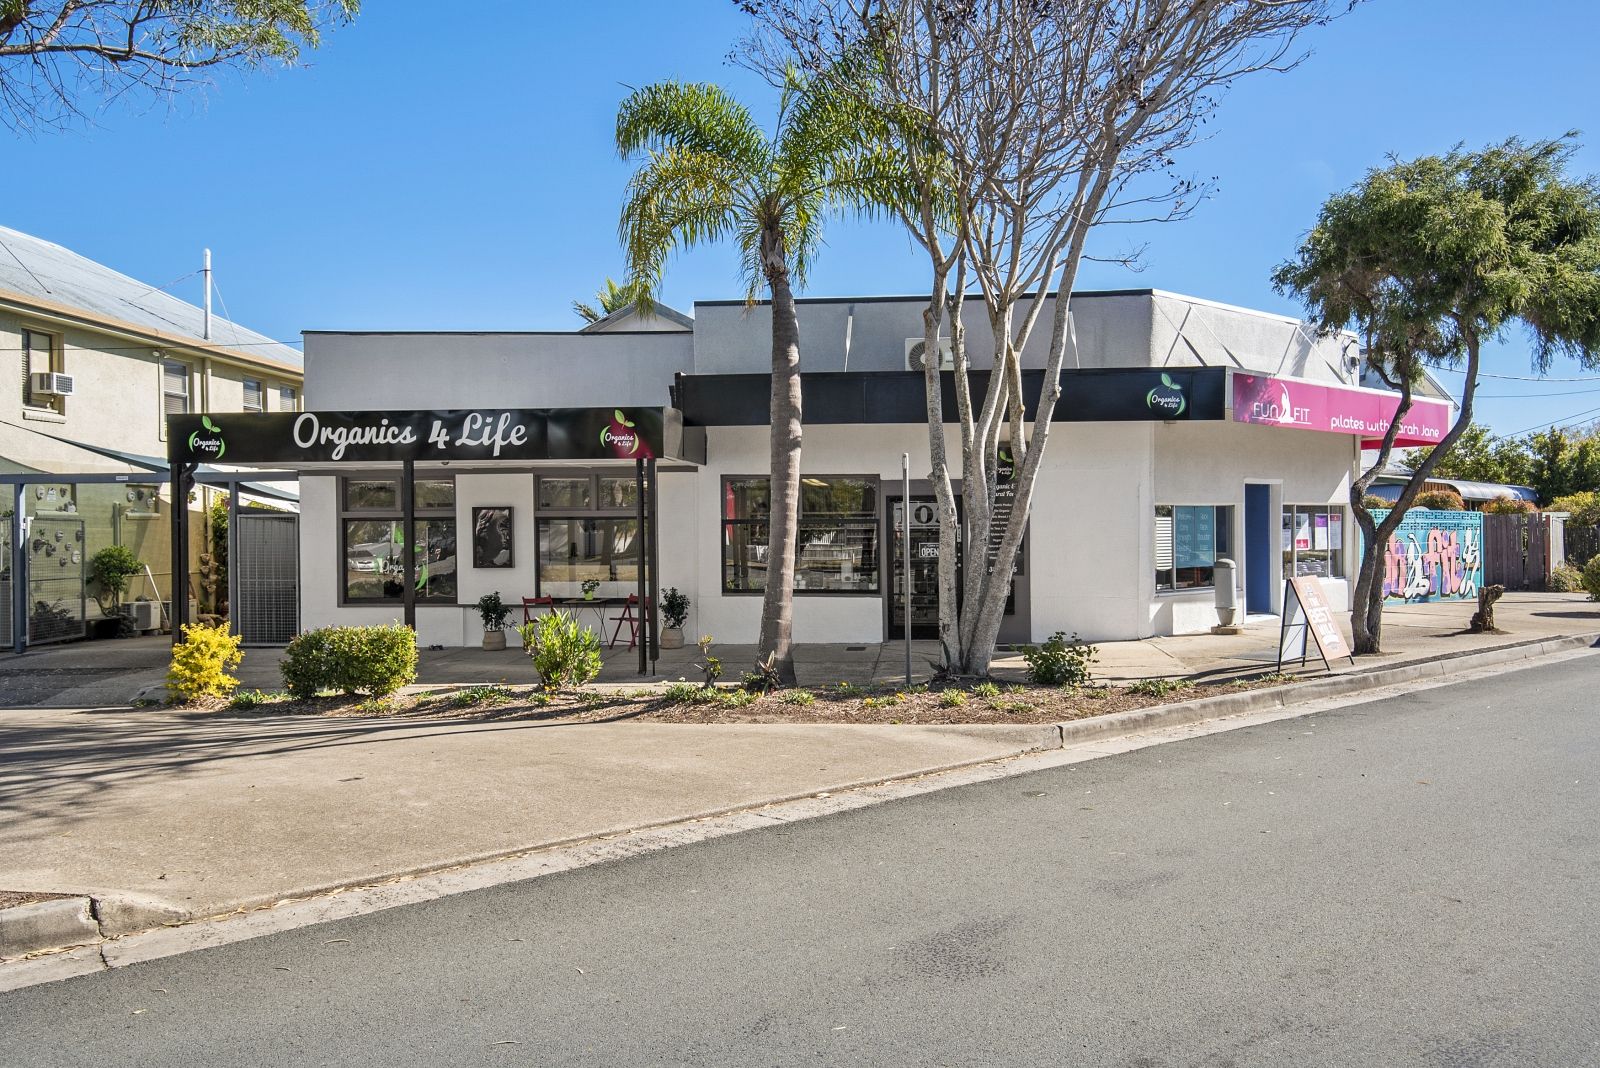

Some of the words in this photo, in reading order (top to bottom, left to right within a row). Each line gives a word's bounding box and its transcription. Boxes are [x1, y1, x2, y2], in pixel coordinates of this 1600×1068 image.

[1151, 394, 1181, 406] Organics
[1293, 407, 1311, 422] FIT
[1331, 414, 1365, 431] pilates
[1366, 419, 1390, 433] with
[1397, 424, 1419, 436] arah
[1421, 424, 1440, 438] Jane
[193, 437, 221, 450] Organics
[293, 412, 417, 461] Organics
[428, 420, 450, 449] 4
[455, 412, 528, 457] Life
[605, 432, 635, 445] Organics
